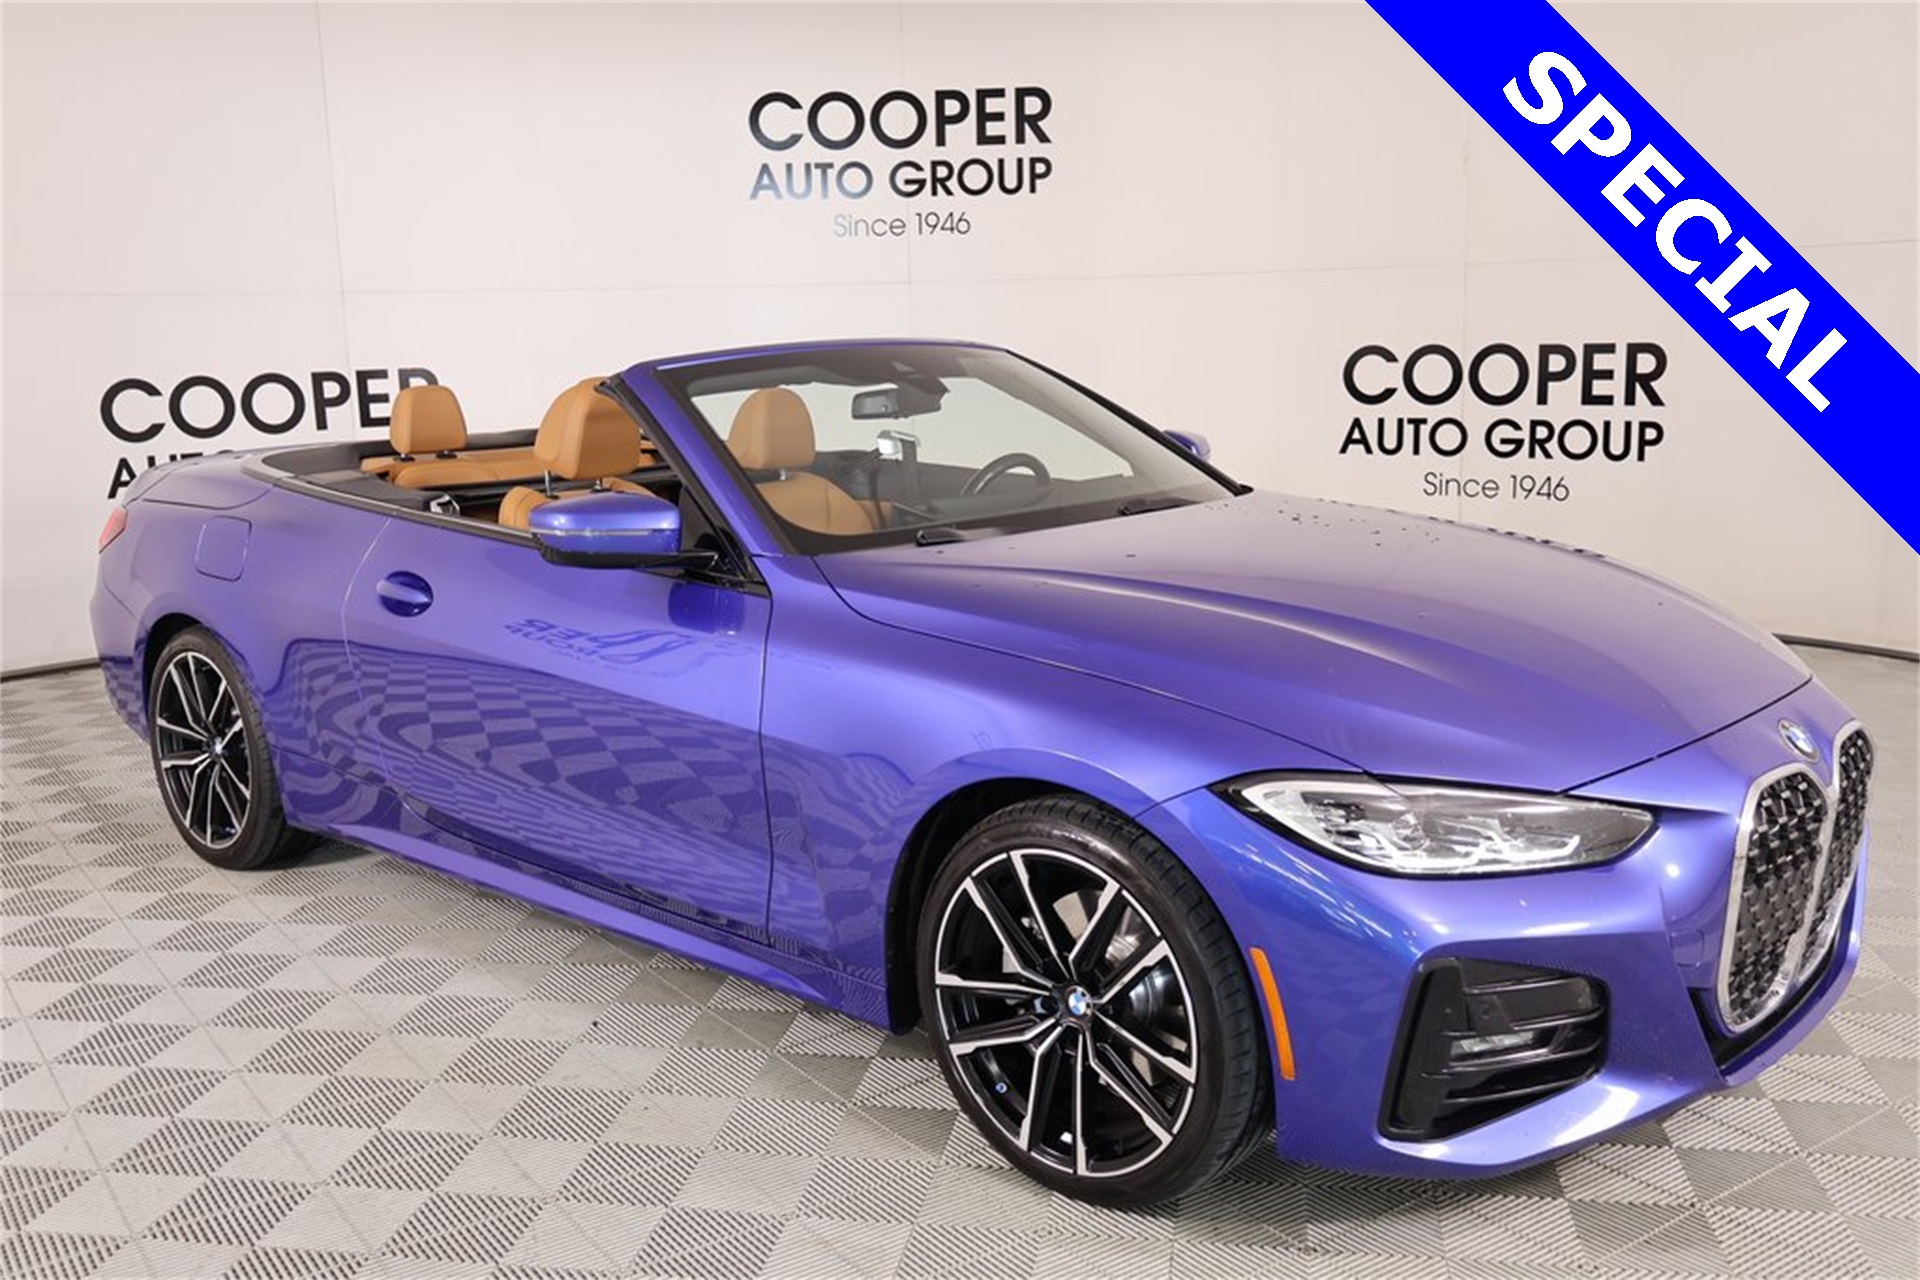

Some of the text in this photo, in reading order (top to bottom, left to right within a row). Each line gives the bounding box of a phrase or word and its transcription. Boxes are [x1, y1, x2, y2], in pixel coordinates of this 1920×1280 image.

[748, 86, 1053, 151] COOPER
[749, 156, 1053, 200] AUTO GROUP
[833, 211, 971, 237] Since 1946
[1342, 342, 1668, 407] COOPER
[1338, 417, 1665, 462] AUTO GROUP
[1422, 471, 1571, 502] Since 1946
